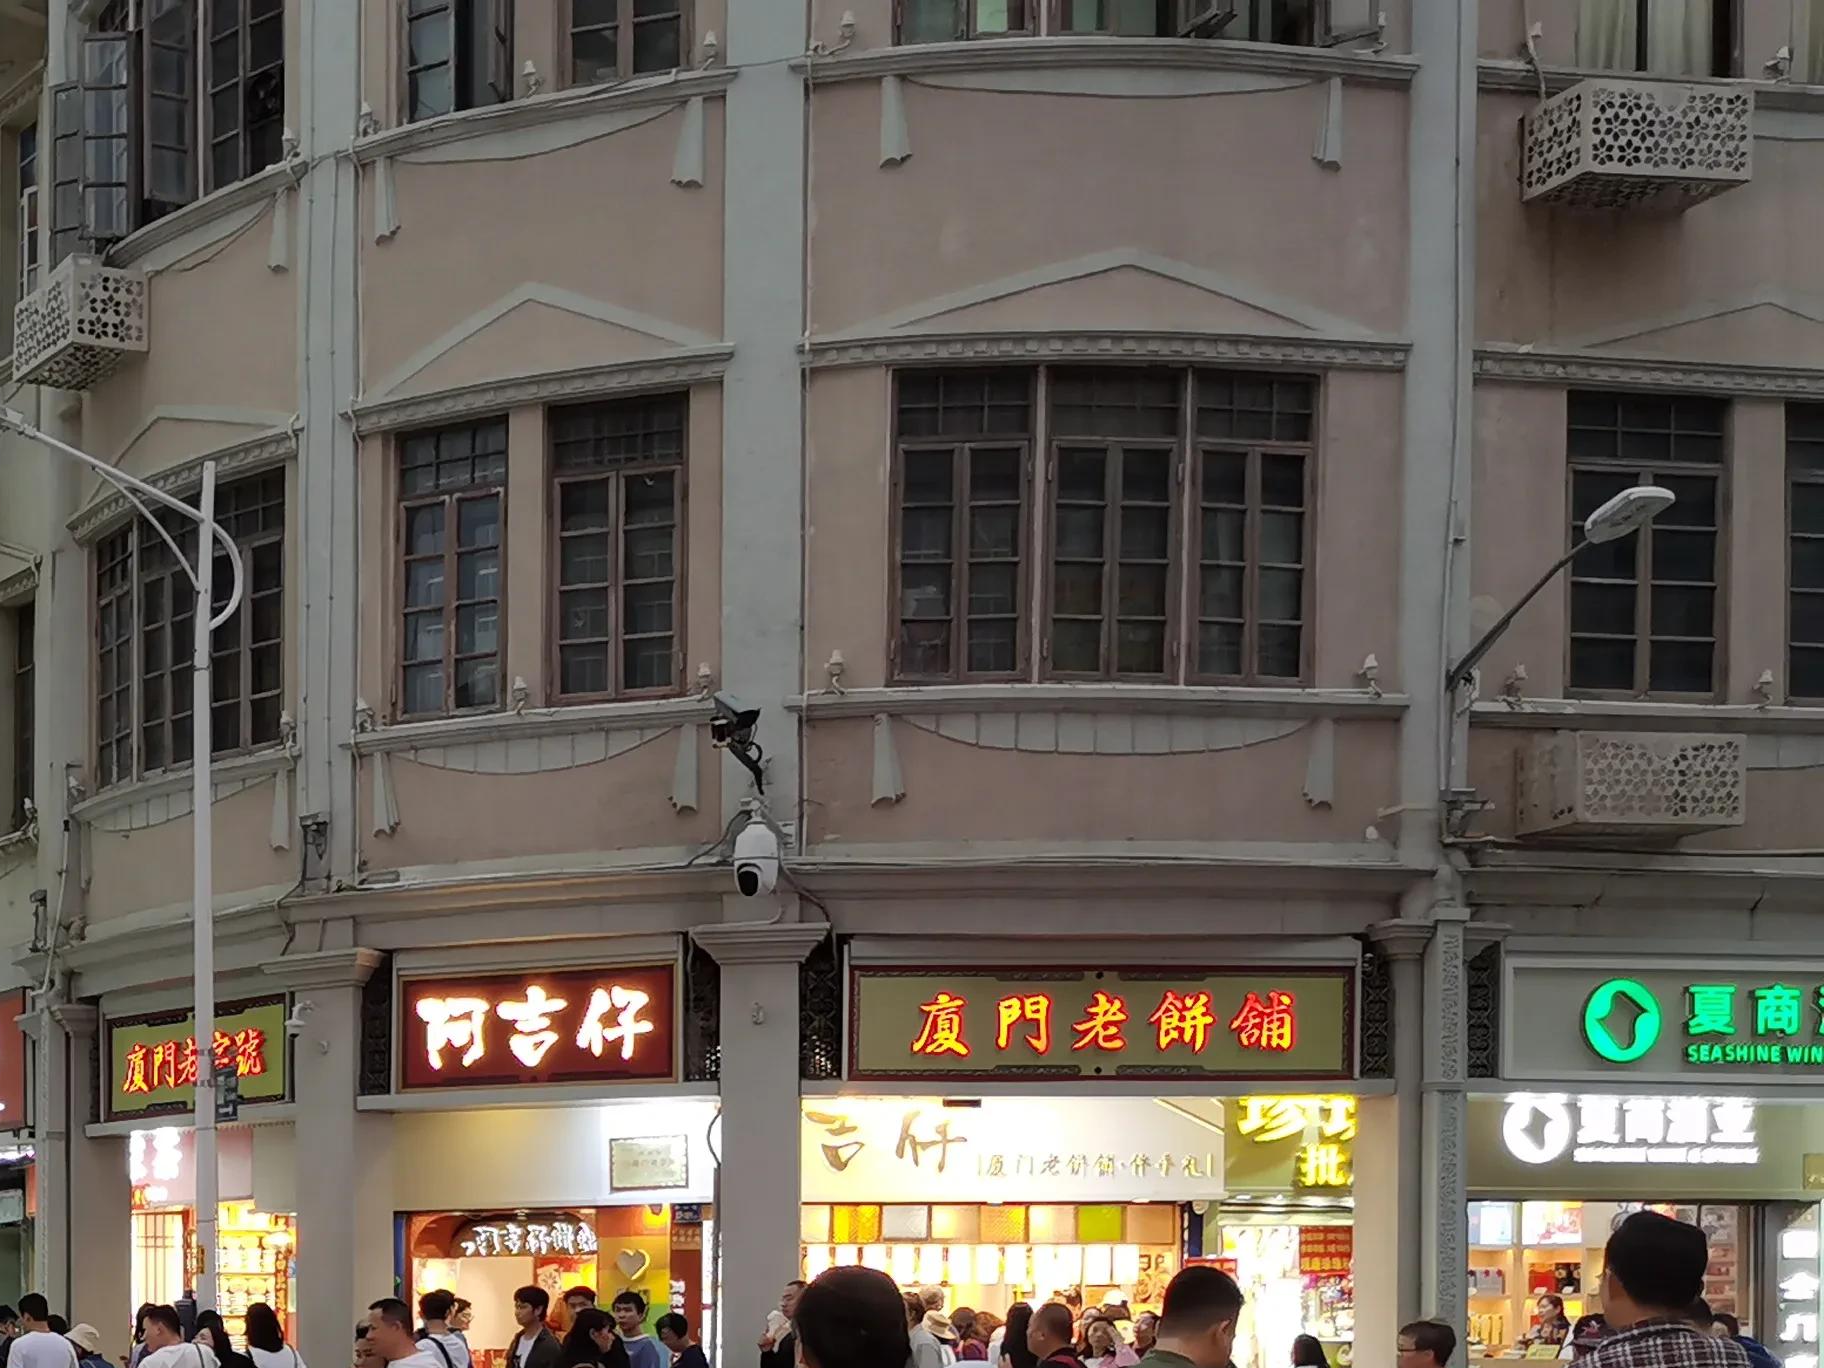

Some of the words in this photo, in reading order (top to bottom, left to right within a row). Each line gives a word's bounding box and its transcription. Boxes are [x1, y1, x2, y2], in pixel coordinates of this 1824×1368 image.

[417, 984, 654, 1070] 阿吉仔
[1685, 983, 1824, 1037] 夏商
[1687, 1043, 1782, 1065] SEASHINE
